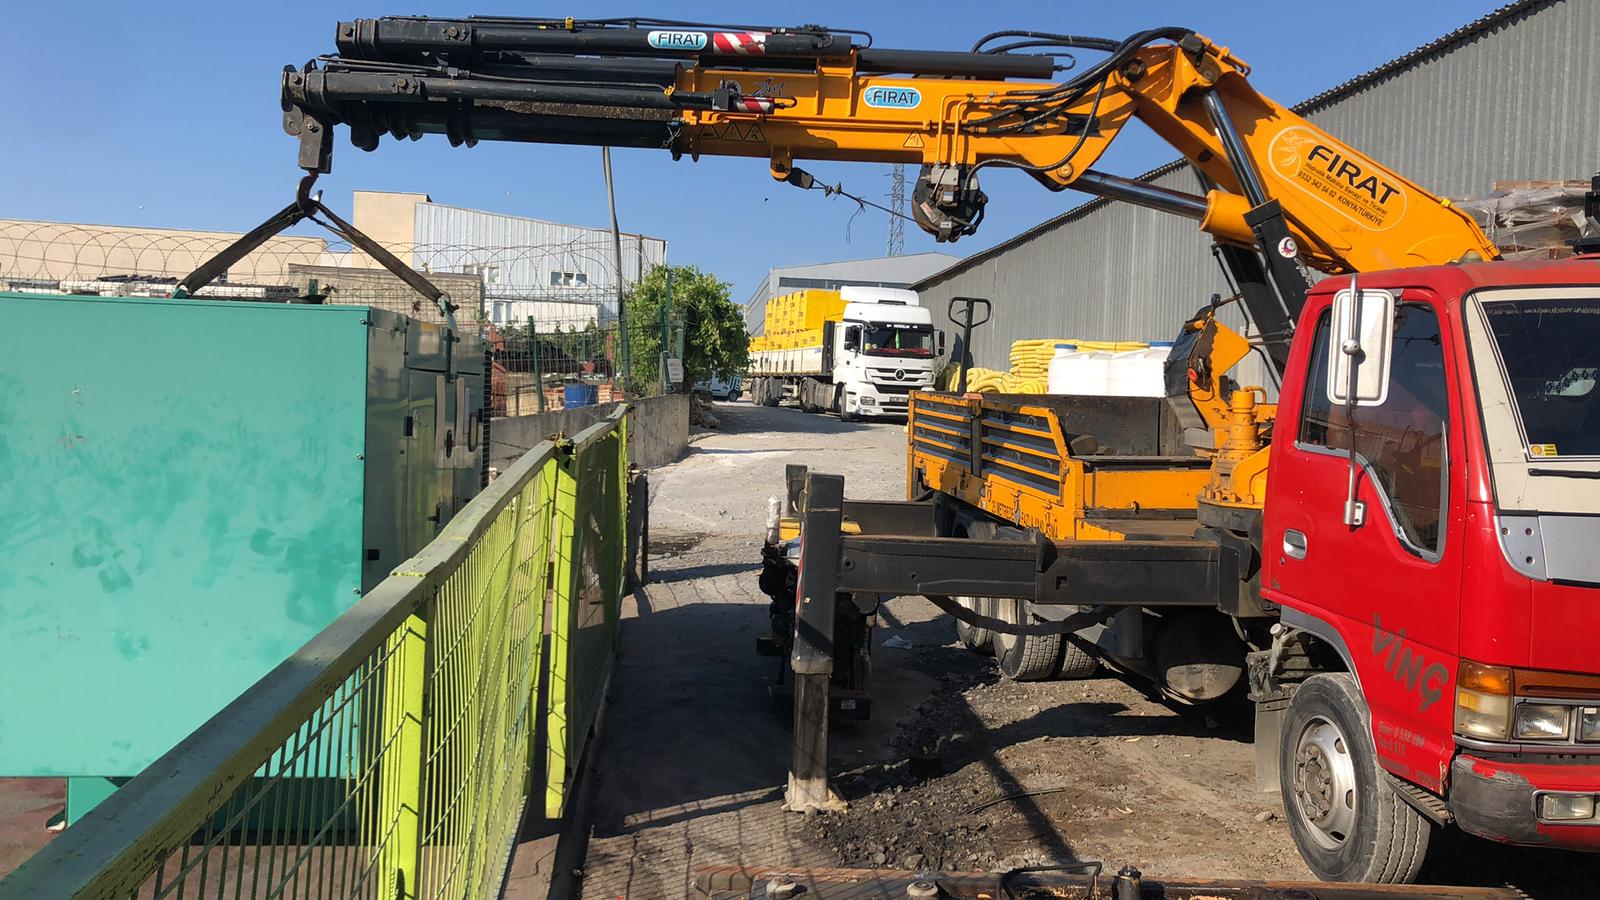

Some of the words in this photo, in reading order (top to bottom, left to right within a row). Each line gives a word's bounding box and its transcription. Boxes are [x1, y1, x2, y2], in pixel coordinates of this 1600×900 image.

[658, 32, 703, 46] FIRAT
[873, 90, 917, 105] FIRAT
[1298, 169, 1312, 183] 0332
[1337, 193, 1384, 227] KONYA/TÜRKİYE
[1305, 162, 1326, 178] Hidrolik
[1325, 173, 1345, 191] Makina
[1344, 184, 1362, 200] Sanayi
[1369, 197, 1388, 216] Ticaret
[1307, 144, 1401, 205] FIRAT
[1371, 611, 1449, 713] VİNÇ
